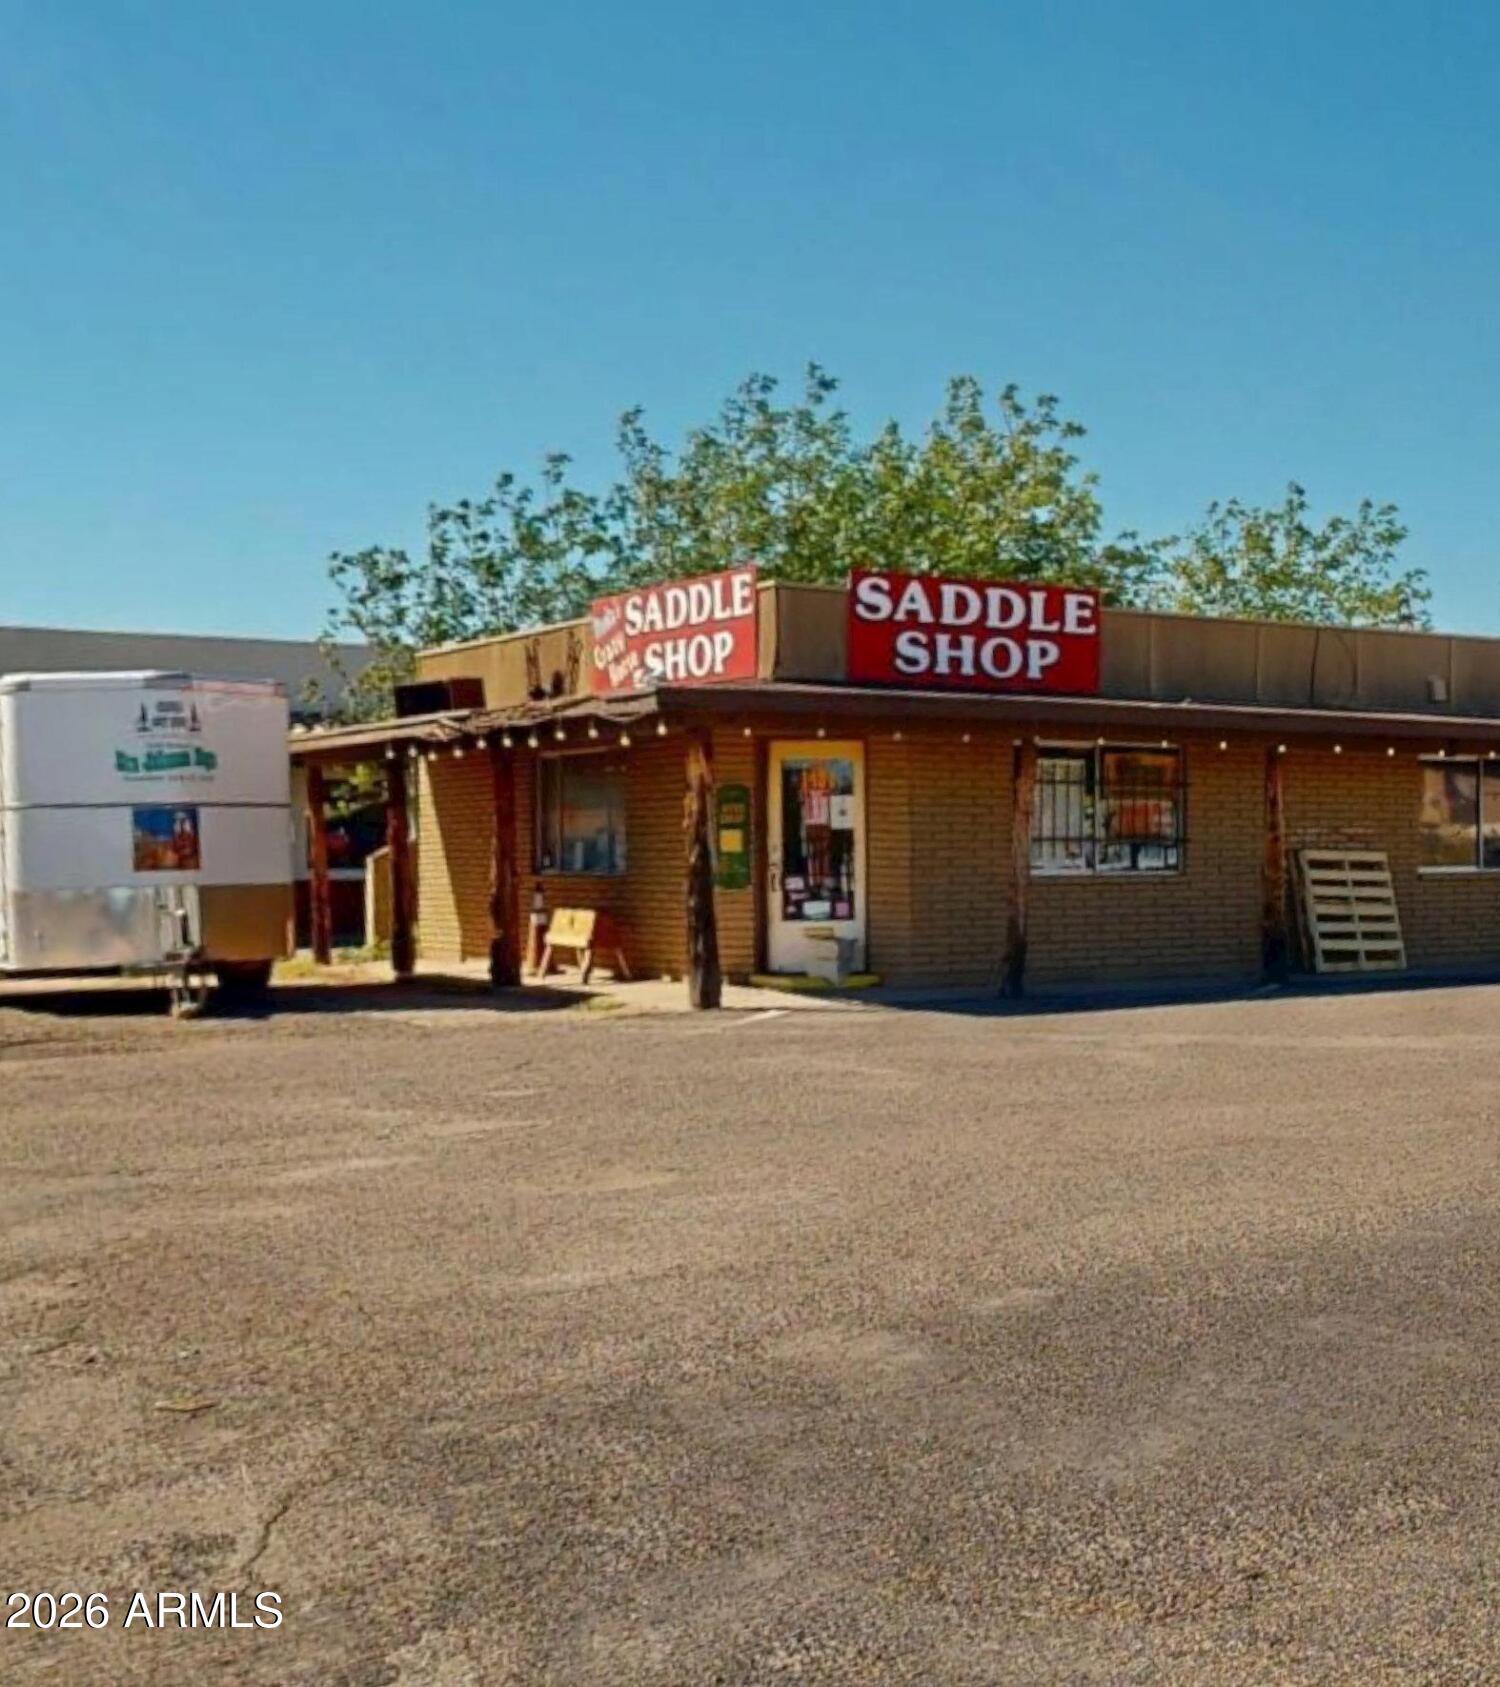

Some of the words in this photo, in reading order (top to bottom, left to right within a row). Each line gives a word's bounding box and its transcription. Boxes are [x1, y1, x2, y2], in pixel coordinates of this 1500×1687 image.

[624, 572, 754, 636] SADDLE
[855, 576, 1097, 635] SADDLE
[644, 630, 733, 681] SHOP
[895, 631, 1060, 680] SHOP
